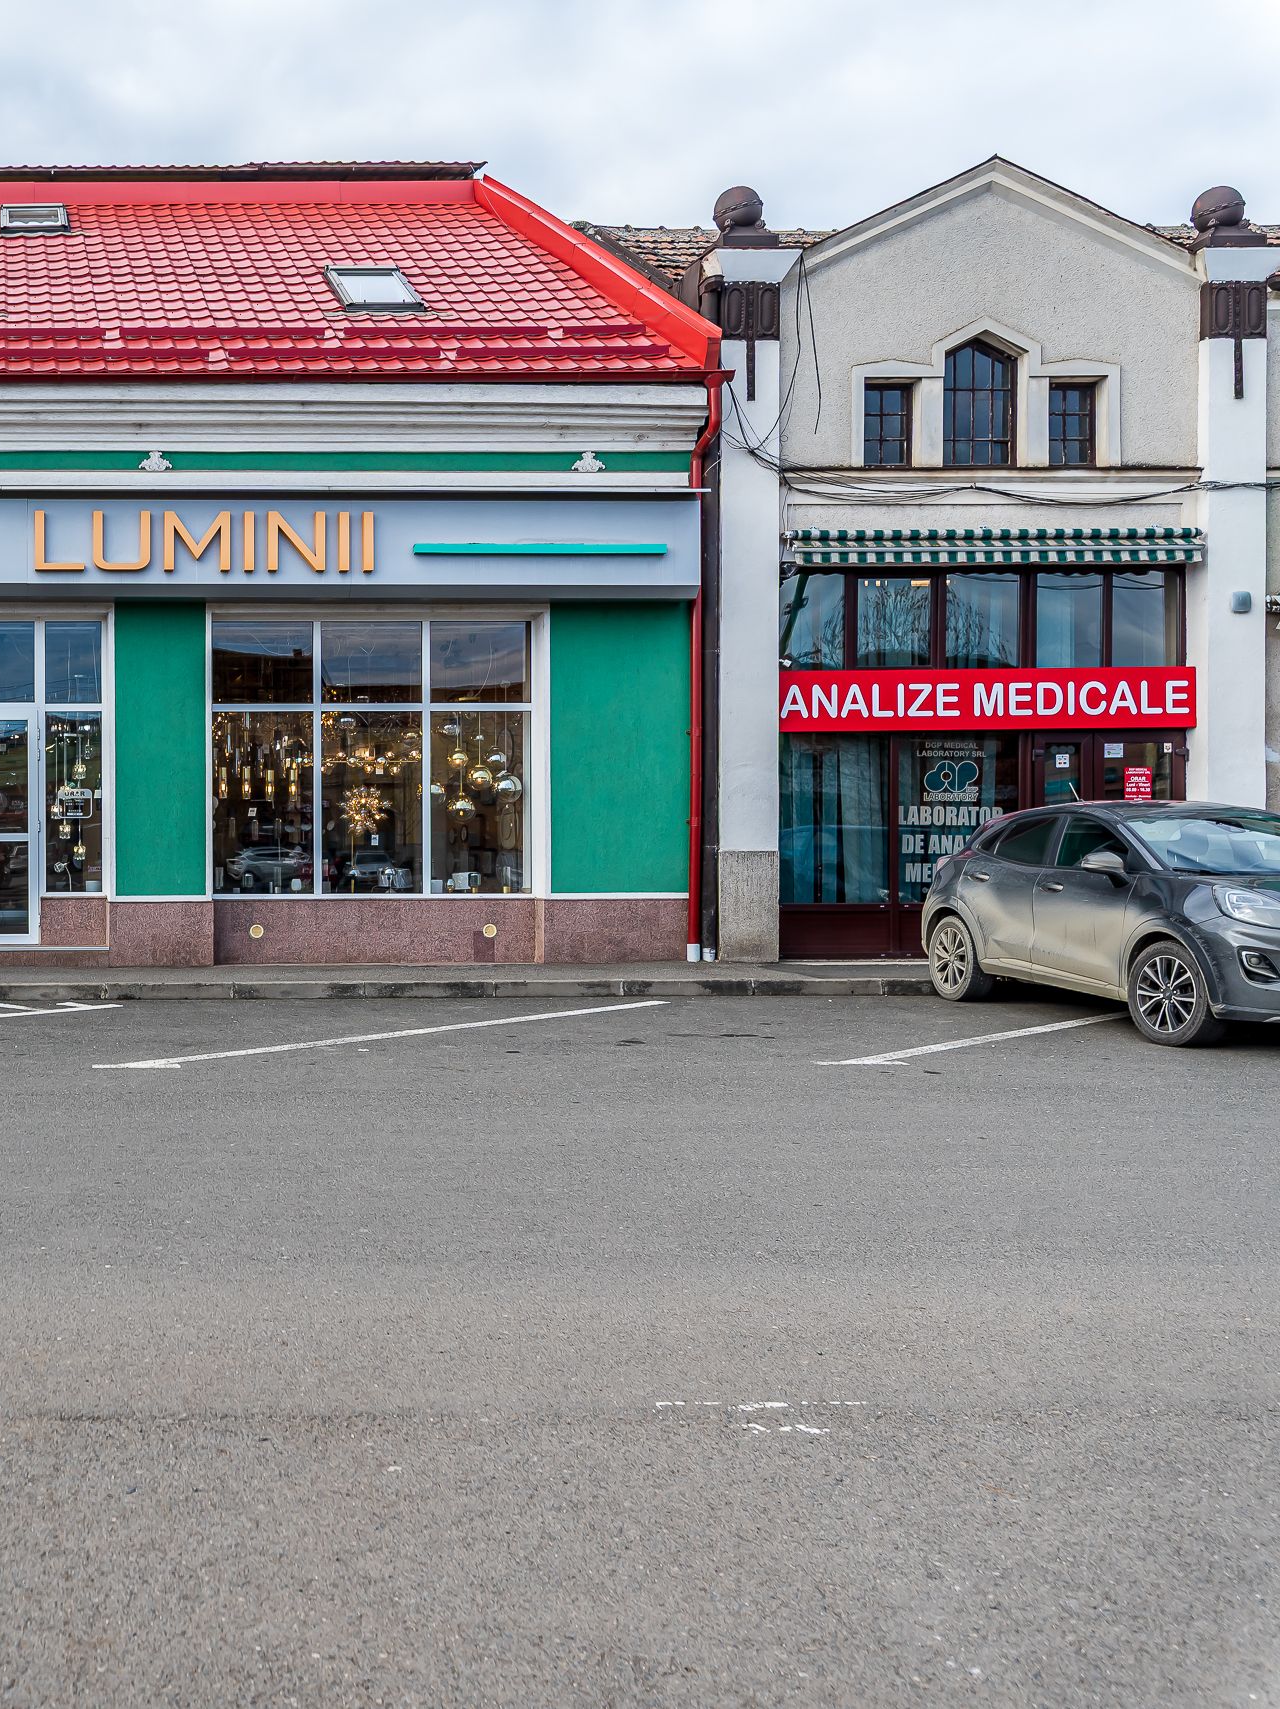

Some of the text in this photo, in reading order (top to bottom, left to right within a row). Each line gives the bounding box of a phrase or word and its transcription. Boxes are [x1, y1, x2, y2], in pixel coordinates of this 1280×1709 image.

[34, 510, 374, 573] LUMINII
[780, 680, 1190, 719] ANALIZE MEDICALE
[925, 741, 979, 749] DGP MEDICAL
[971, 750, 987, 758] SRL
[923, 792, 979, 802] LABORATORY
[901, 834, 971, 854] DE ANA
[905, 862, 937, 883] ME
